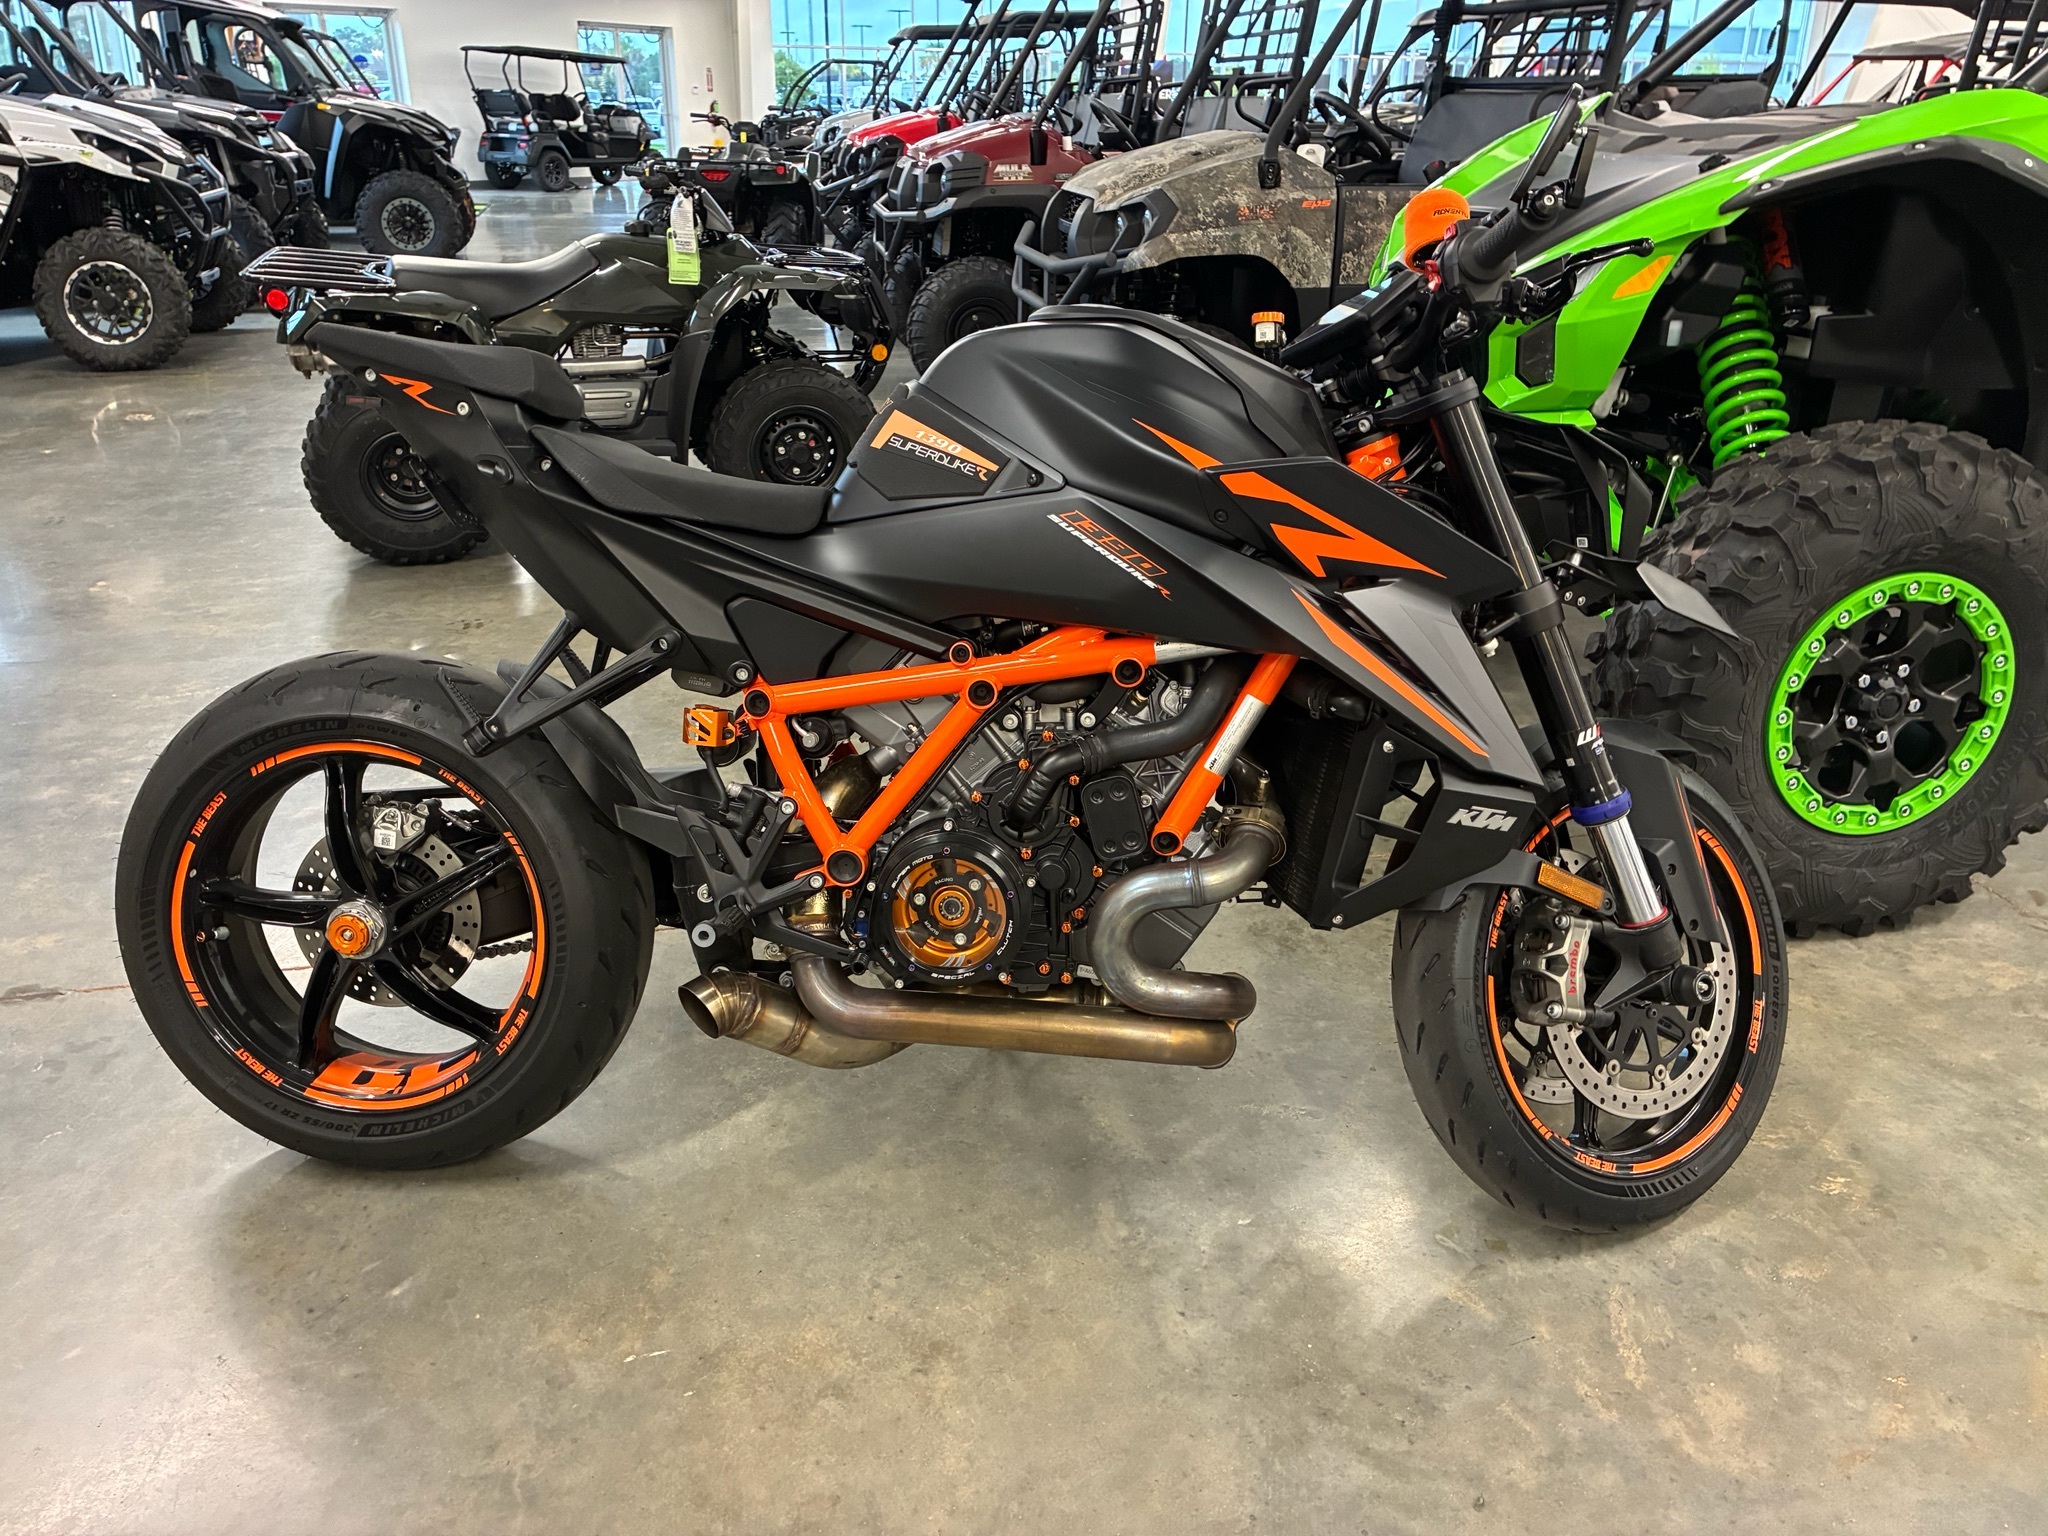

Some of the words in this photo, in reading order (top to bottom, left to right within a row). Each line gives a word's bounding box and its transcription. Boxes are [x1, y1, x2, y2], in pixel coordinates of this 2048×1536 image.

[914, 430, 964, 454] 1390
[438, 768, 457, 783] THE
[456, 780, 486, 806] BEAST
[190, 817, 208, 838] THE
[201, 790, 228, 821] BEAST
[1446, 805, 1518, 832] KTM
[1494, 890, 1509, 927] BEAST
[1489, 927, 1500, 949] THE
[1567, 940, 1581, 996] brembo
[513, 1008, 529, 1029] THE
[495, 1025, 519, 1056] BEAST
[1748, 1019, 1762, 1055] BEAST
[234, 1048, 266, 1075] BEAST
[261, 1069, 284, 1087] THE
